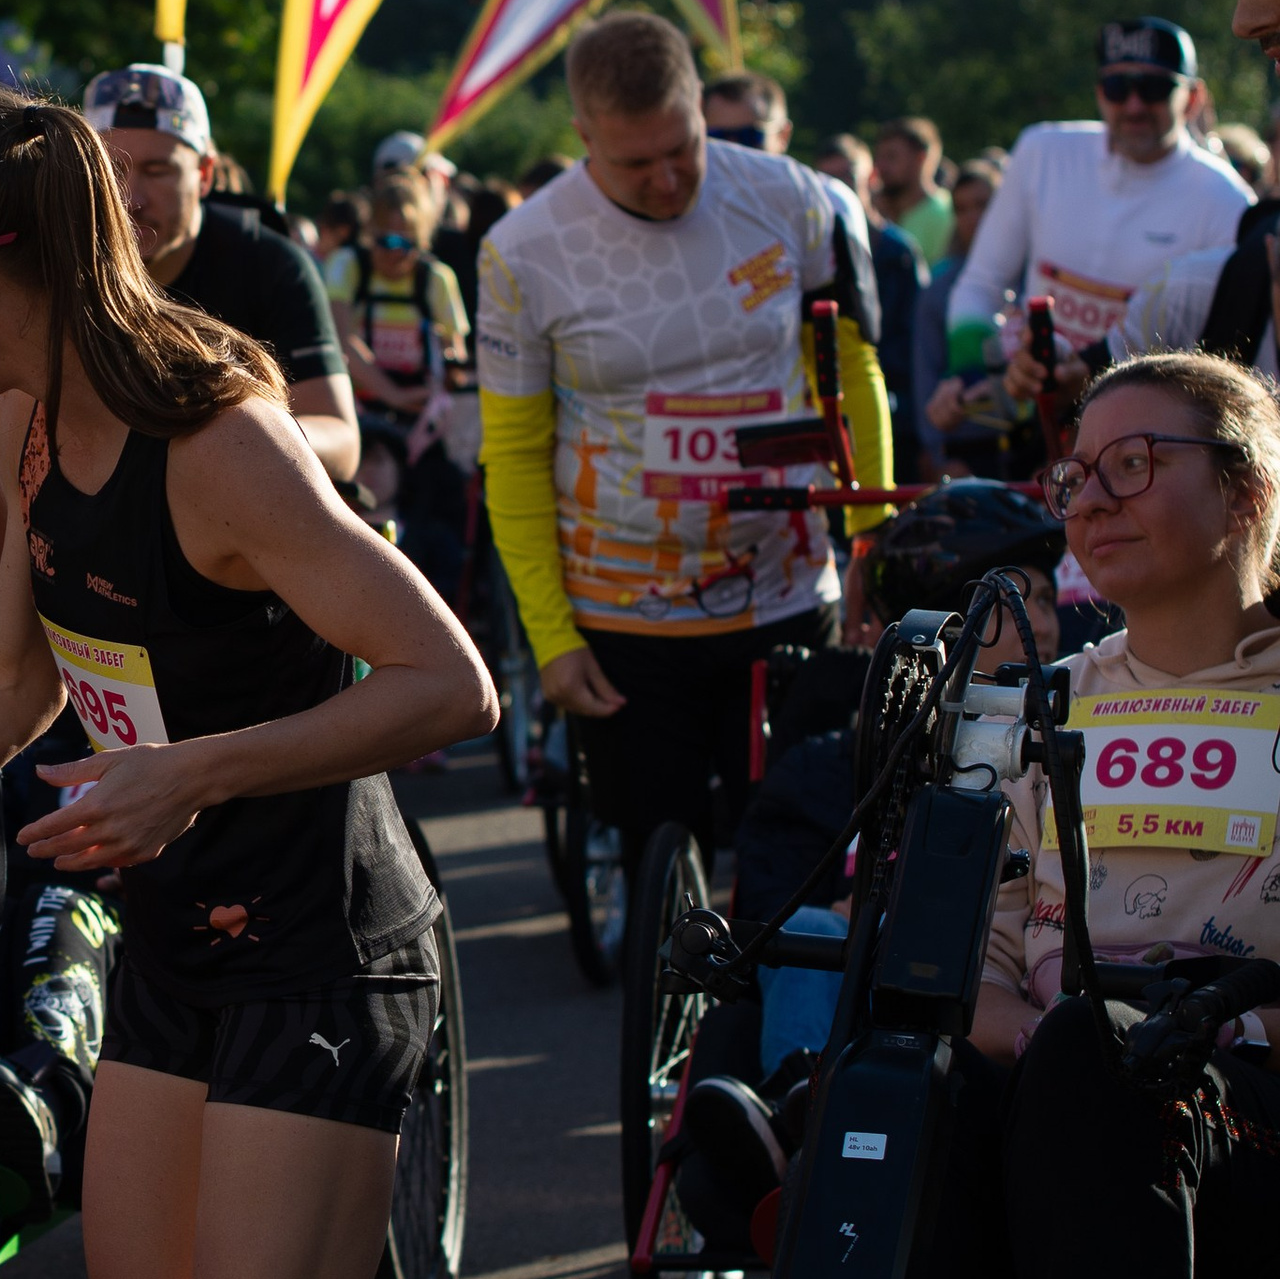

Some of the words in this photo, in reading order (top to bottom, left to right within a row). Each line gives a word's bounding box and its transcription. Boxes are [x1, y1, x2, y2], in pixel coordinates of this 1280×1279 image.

[98, 586, 138, 608] ATHLETICS
[93, 648, 124, 668] ЗАБЕГ
[62, 667, 137, 746] 695
[1091, 696, 1206, 717] ИНКЛЮЗИВНЫЙ
[1210, 699, 1262, 716] ЗАБЕГ
[1095, 737, 1237, 790] 689
[1117, 813, 1160, 838] 5,5
